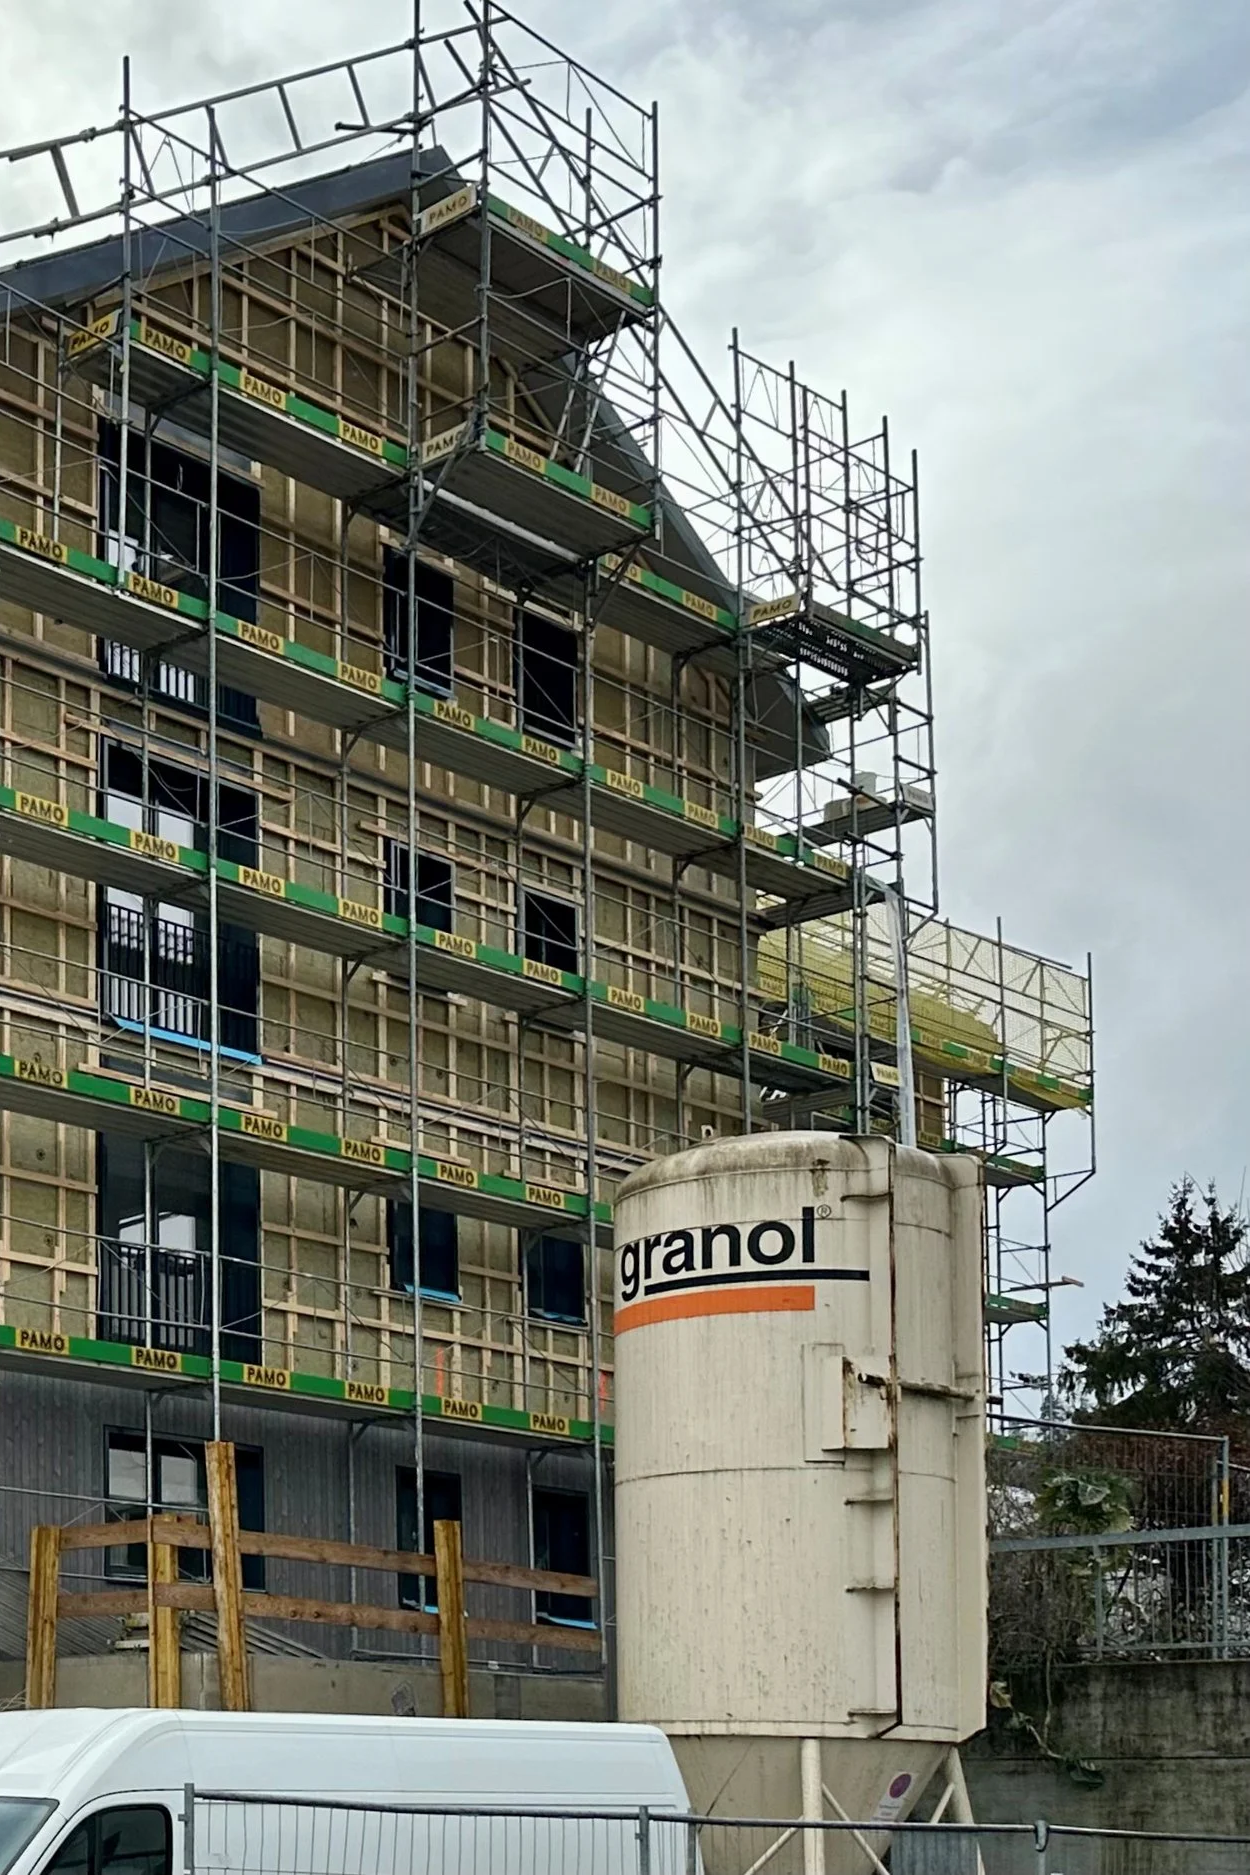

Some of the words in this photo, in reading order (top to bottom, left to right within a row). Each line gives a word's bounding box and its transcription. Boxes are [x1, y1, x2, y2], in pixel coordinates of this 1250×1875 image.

[429, 196, 467, 224] PAMO
[143, 330, 187, 359] PAMO
[244, 378, 282, 404] PAMO
[343, 426, 379, 450] PAMO
[507, 441, 542, 469] PAMO
[595, 487, 626, 512] PAMO
[20, 531, 62, 559] PAMO
[132, 576, 173, 604] PAMO
[686, 594, 713, 618] PAMO
[753, 599, 792, 618] PAMO
[242, 625, 279, 649] PAMO
[341, 663, 377, 689] PAMO
[437, 703, 471, 727] PAMO
[525, 738, 557, 761] PAMO
[610, 772, 640, 794] PAMO
[20, 797, 63, 822] PAMO
[688, 804, 716, 825] PAMO
[135, 835, 176, 858] PAMO
[244, 871, 282, 893] PAMO
[343, 902, 379, 924] PAMO
[439, 935, 472, 955] PAMO
[527, 961, 558, 982] PAMO
[611, 989, 641, 1009] PAMO
[690, 1016, 718, 1032] PAMO
[751, 1035, 779, 1052] PAMO
[19, 1061, 62, 1085] PAMO
[822, 1057, 847, 1074] PAMO
[135, 1091, 175, 1111] PAMO
[245, 1118, 282, 1138] PAMO
[345, 1141, 381, 1161] PAMO
[440, 1166, 474, 1184] PAMO
[529, 1188, 561, 1205] PAMO
[621, 1206, 815, 1301] granol
[21, 1330, 64, 1351] PAMO
[137, 1351, 177, 1369] PAMO
[248, 1369, 286, 1386] PAMO
[349, 1384, 384, 1402] PAMO
[444, 1402, 478, 1418] PAMO
[533, 1416, 564, 1431] PAMO
